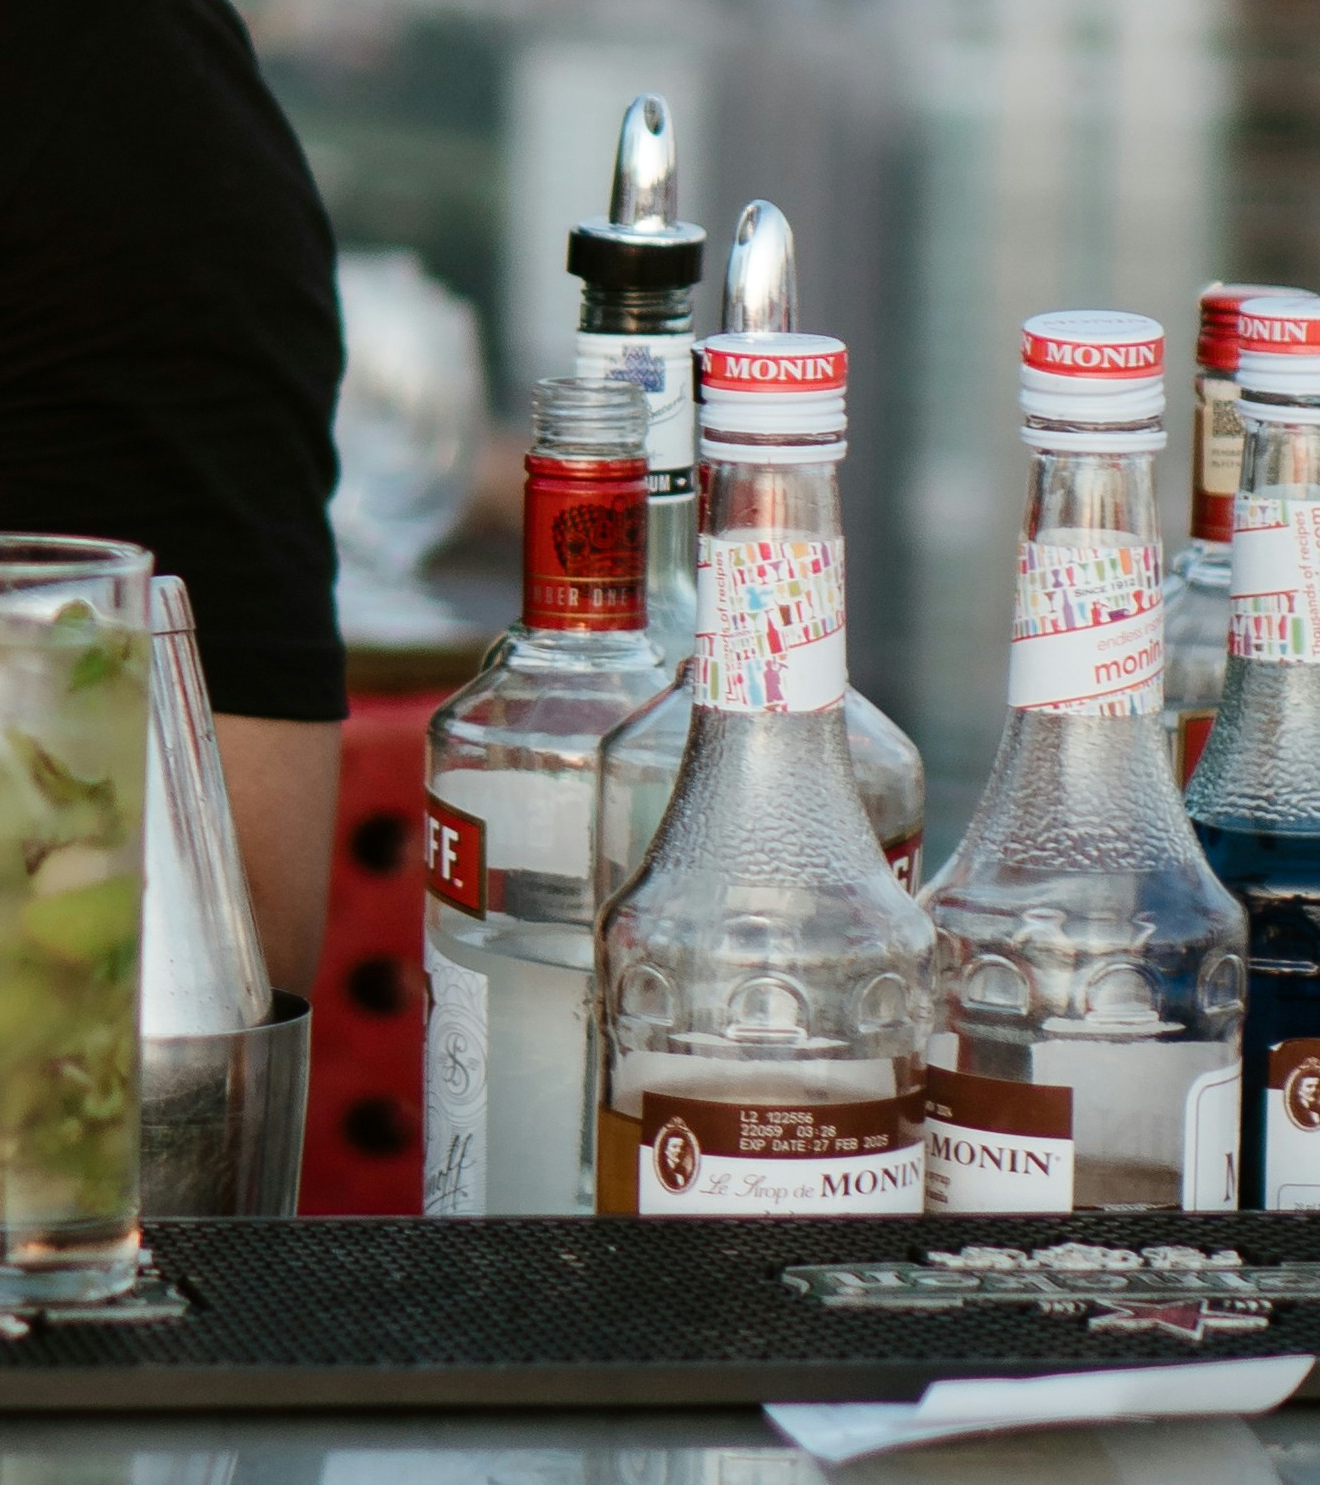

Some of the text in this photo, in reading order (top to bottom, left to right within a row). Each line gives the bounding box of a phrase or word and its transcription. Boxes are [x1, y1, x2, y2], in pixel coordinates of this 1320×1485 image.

[1238, 315, 1309, 343] ONIN
[1044, 341, 1157, 368] MONIN
[724, 356, 835, 381] MONIN
[647, 474, 671, 493] UM
[1295, 510, 1311, 561] recipes
[740, 1110, 759, 1123] L2
[739, 1138, 766, 1151] EXP
[930, 1132, 1053, 1176] MONIN
[699, 1173, 732, 1196] Le
[734, 1173, 789, 1205] Sirop
[793, 1182, 815, 1199] de
[820, 1157, 923, 1199] MONIN
[823, 1268, 1320, 1294] eineken
